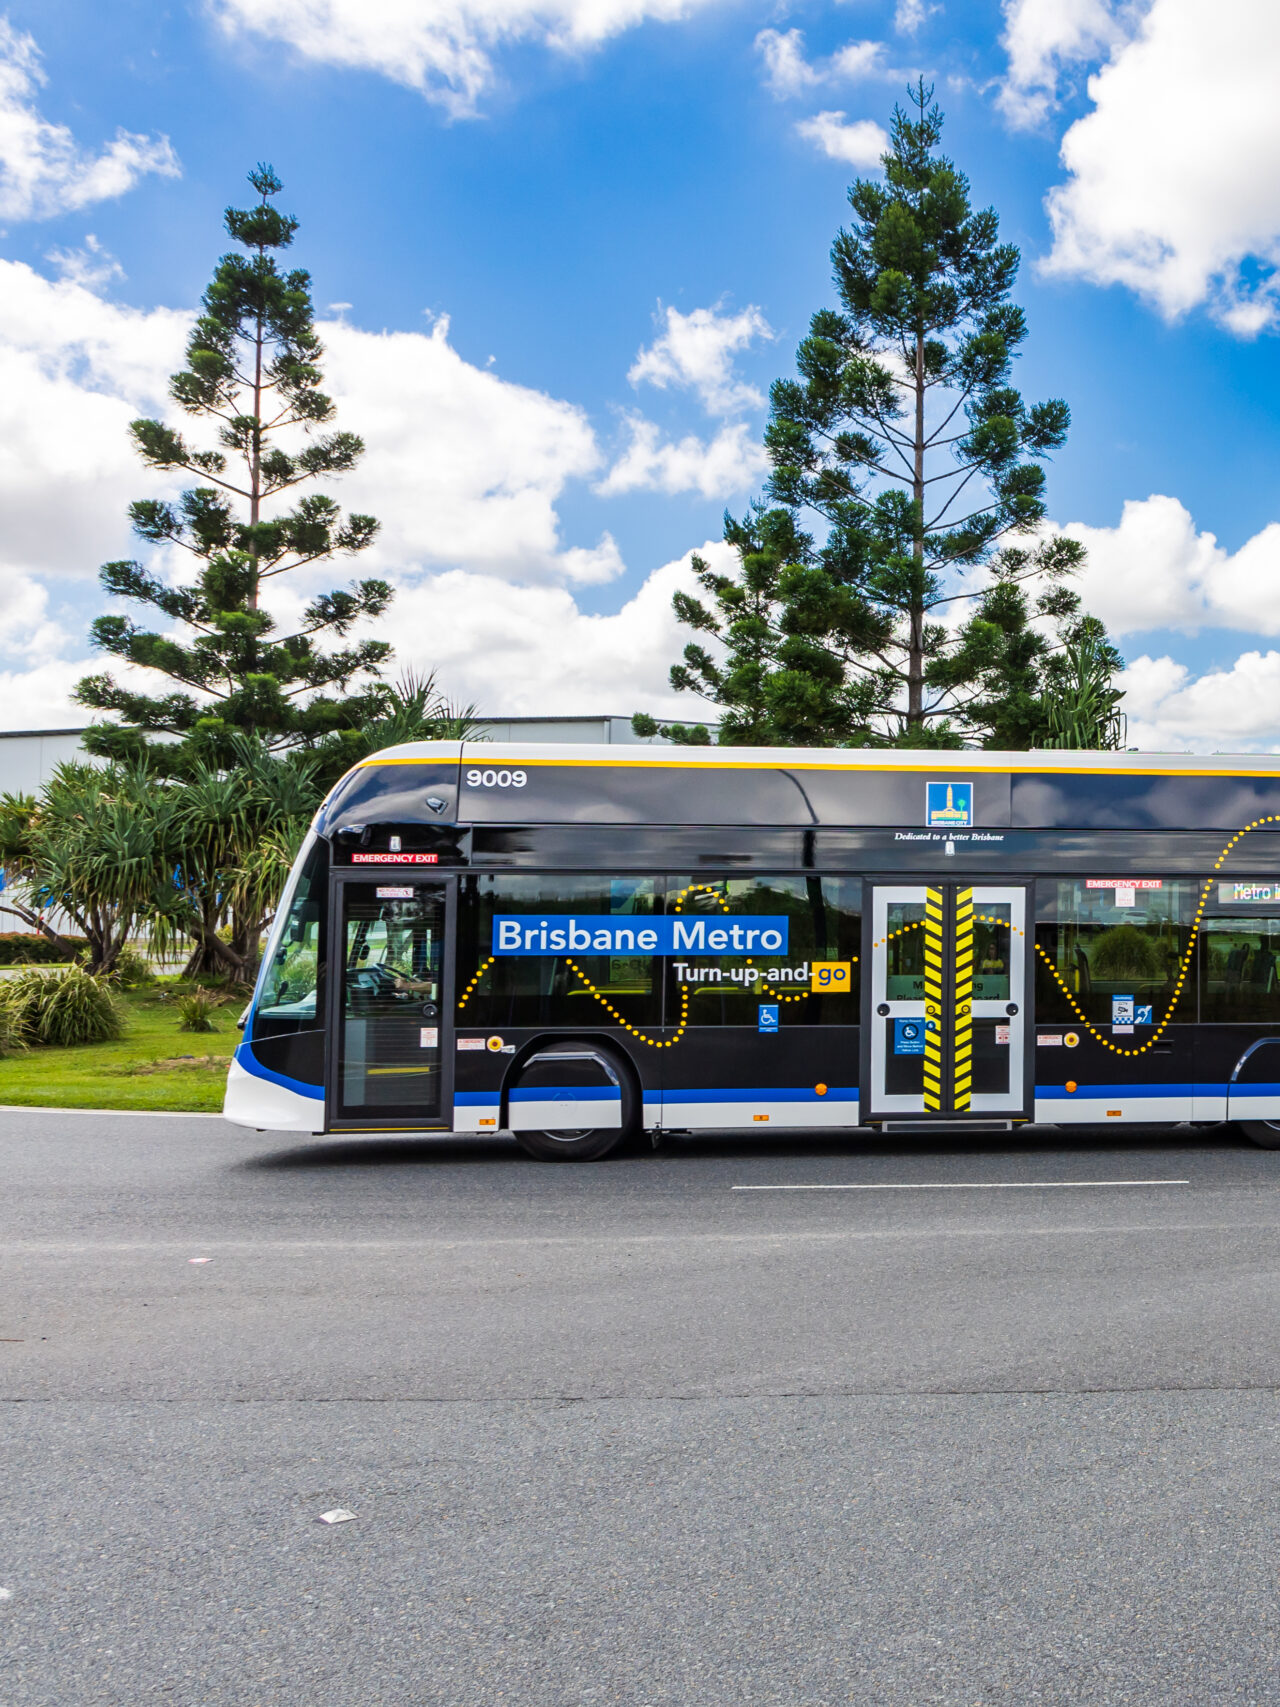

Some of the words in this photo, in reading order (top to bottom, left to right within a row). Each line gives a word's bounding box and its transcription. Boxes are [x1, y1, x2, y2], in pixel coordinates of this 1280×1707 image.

[466, 769, 528, 788] 9009
[894, 832, 932, 841] Dedicated
[932, 833, 941, 841] to
[949, 832, 969, 841] better
[971, 833, 1004, 841] Brisbane
[353, 853, 413, 863] EMERGENCY
[415, 853, 437, 863] EXIT
[1087, 880, 1140, 888] EMERGENCY
[1142, 880, 1161, 888] EXIT
[1234, 883, 1271, 900] Metro
[499, 919, 658, 950] Brisbane
[672, 920, 782, 950] Metro
[672, 961, 846, 986] Turn-up-and-go
